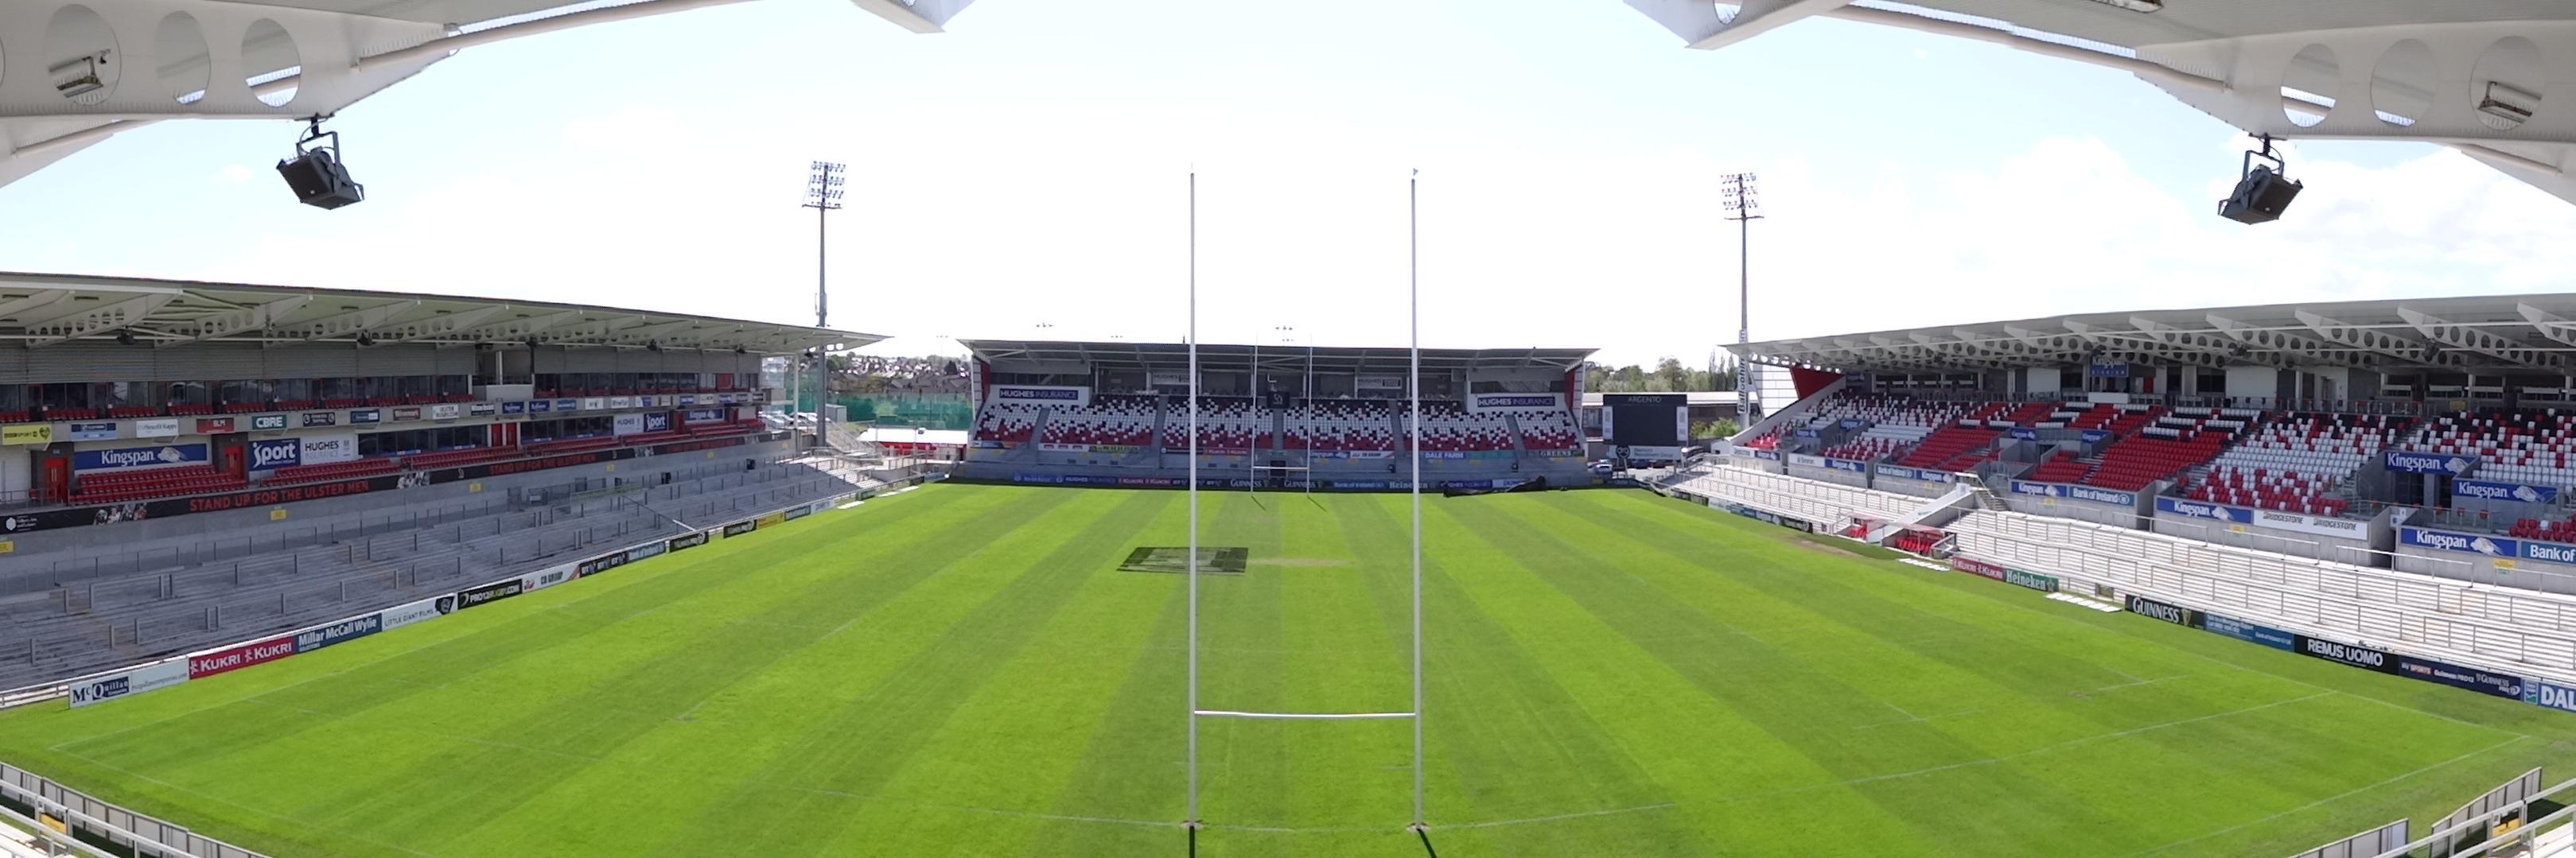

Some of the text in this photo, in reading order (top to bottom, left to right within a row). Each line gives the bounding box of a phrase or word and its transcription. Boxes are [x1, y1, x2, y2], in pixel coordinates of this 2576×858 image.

[1000, 389, 1034, 398] HUGHES
[1478, 398, 1512, 406] HUGHES
[255, 417, 283, 428] CBRE
[305, 440, 339, 452] HUGHES
[101, 450, 154, 467] Kingspan
[2387, 452, 2441, 472] Kingspan
[190, 480, 369, 512] STAND UP FOR THE ULSTER MEN
[2073, 487, 2088, 499] Bank
[2096, 491, 2119, 503] Ireland
[2458, 482, 2508, 499] Kingspan
[2173, 501, 2211, 517] Kingspan
[2263, 511, 2356, 531] BRIDGESTONE BRIDGESTONE
[2416, 530, 2467, 549] Kingspan
[2530, 544, 2575, 562] Bank of
[2006, 569, 2047, 591] Heineken
[2132, 596, 2180, 624] GUINNESS
[384, 615, 402, 627] LITTLE
[403, 612, 419, 623] GIANT
[298, 617, 378, 648] Millar McCall Wylie
[200, 642, 292, 673] KUKRI KUKRI
[2307, 639, 2344, 658] REMUS
[2346, 646, 2383, 667] UOMO
[2481, 673, 2510, 687] GUINNESS
